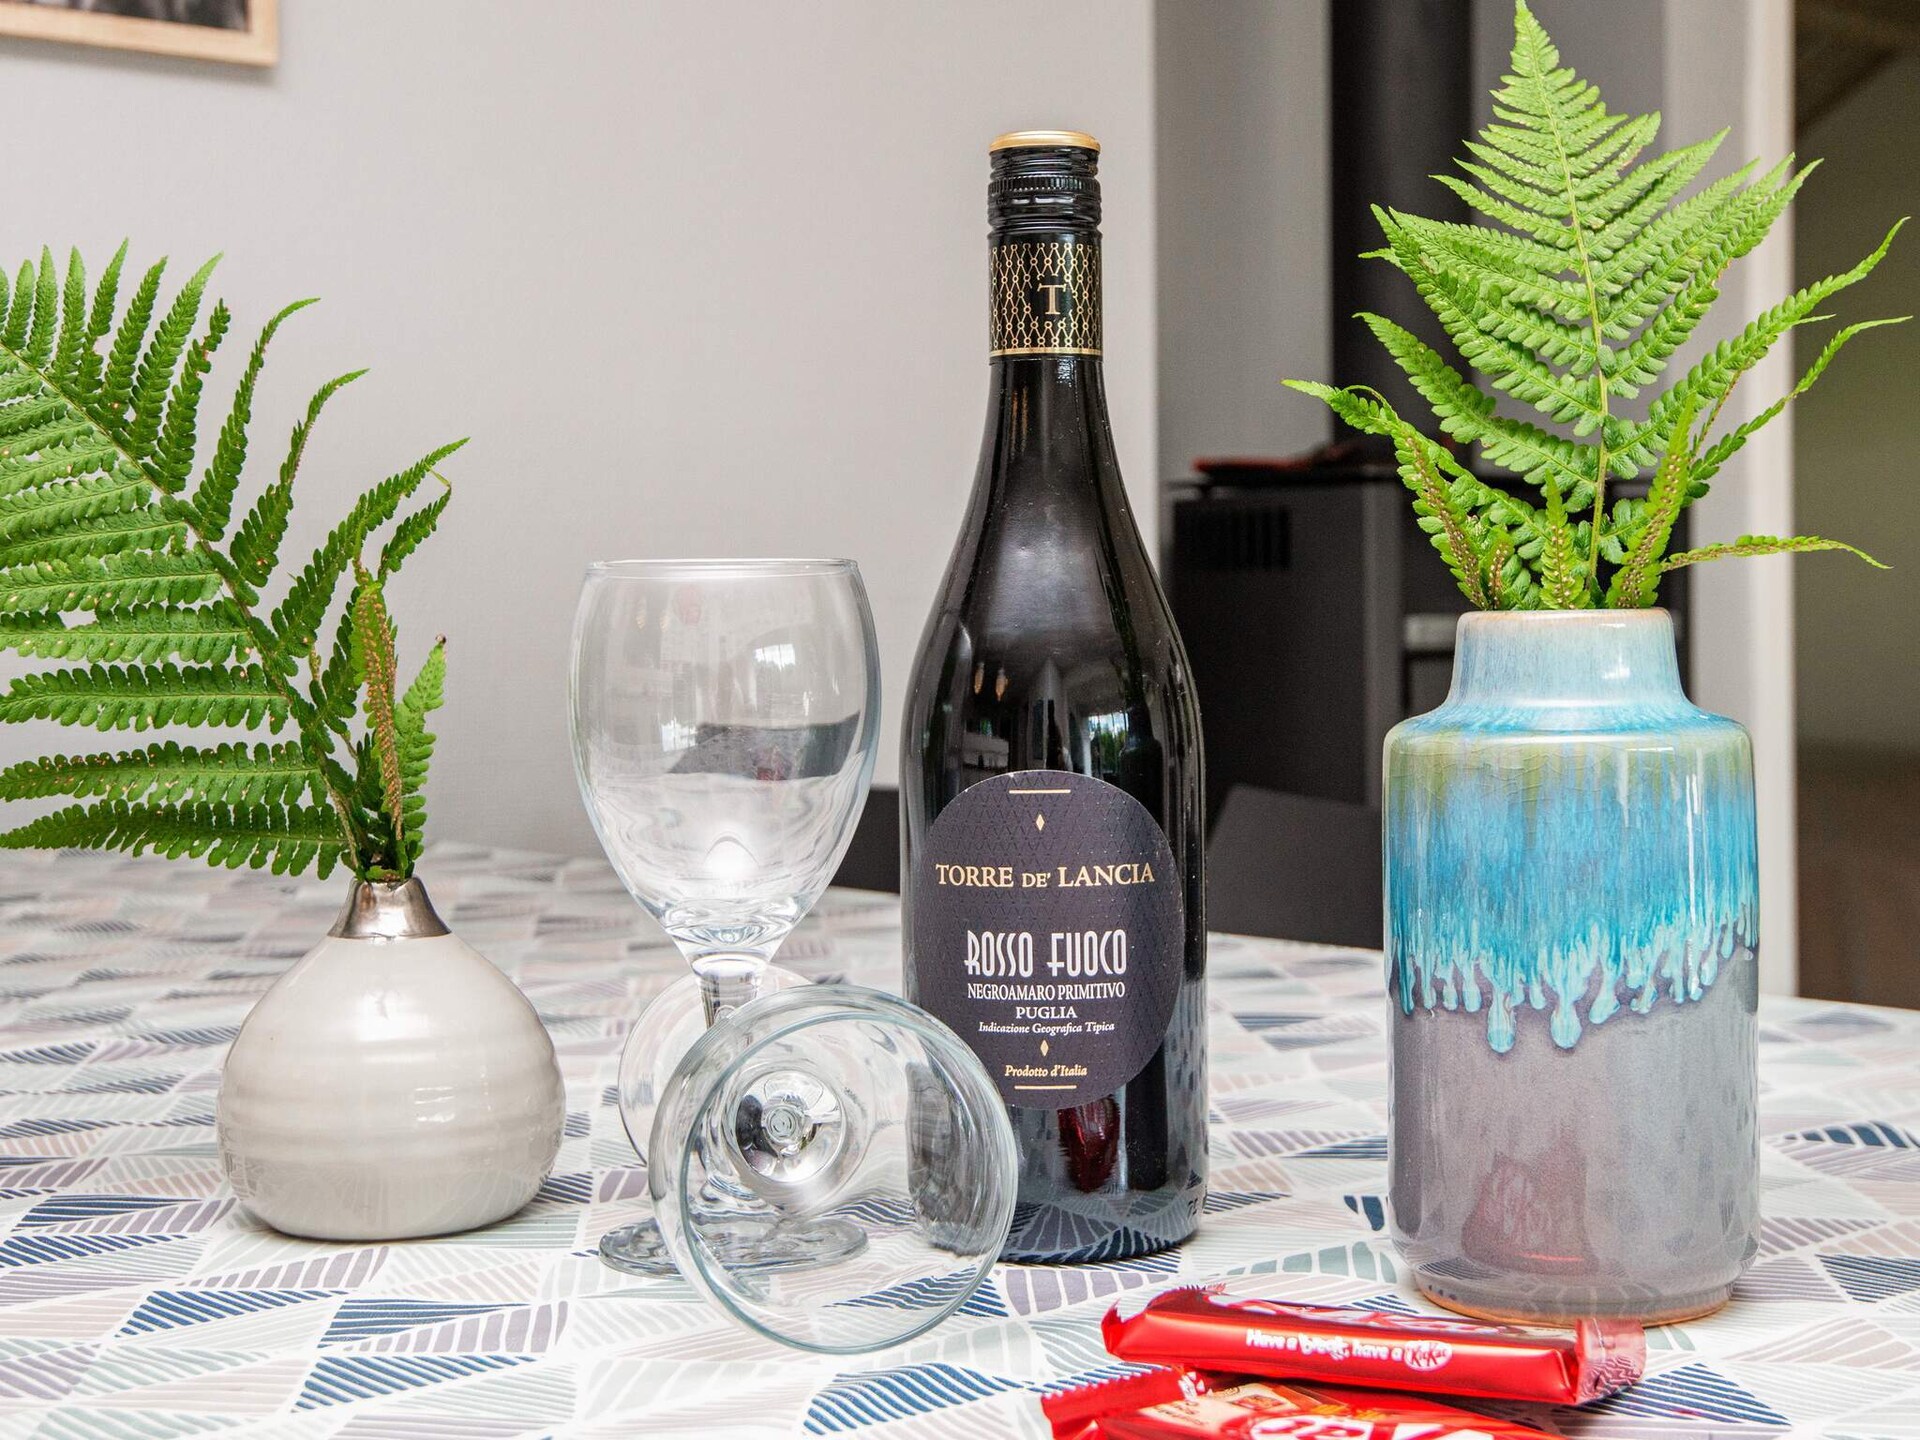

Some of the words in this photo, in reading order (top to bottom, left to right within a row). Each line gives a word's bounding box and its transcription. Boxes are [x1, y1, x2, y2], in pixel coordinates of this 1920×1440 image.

[1037, 282, 1067, 315] T
[935, 863, 1014, 888] TORRE
[1057, 862, 1156, 888] LANCIA
[963, 929, 1034, 978] ROSSO
[1046, 928, 1127, 978] FUOCO
[967, 982, 1056, 1001] NEGROAMARO
[1058, 981, 1126, 1000] PRIMITIVO
[1015, 1006, 1078, 1019] PUGLIA
[978, 1021, 1030, 1034] Indicazione
[1031, 1022, 1083, 1036] Geografica
[1084, 1021, 1115, 1034] Tipica
[1004, 1064, 1049, 1077] Prodotto
[1050, 1064, 1088, 1077] d'Italia
[1245, 1328, 1286, 1351] Have
[1286, 1336, 1298, 1351] a
[1351, 1338, 1390, 1361] have
[1391, 1346, 1403, 1362] a
